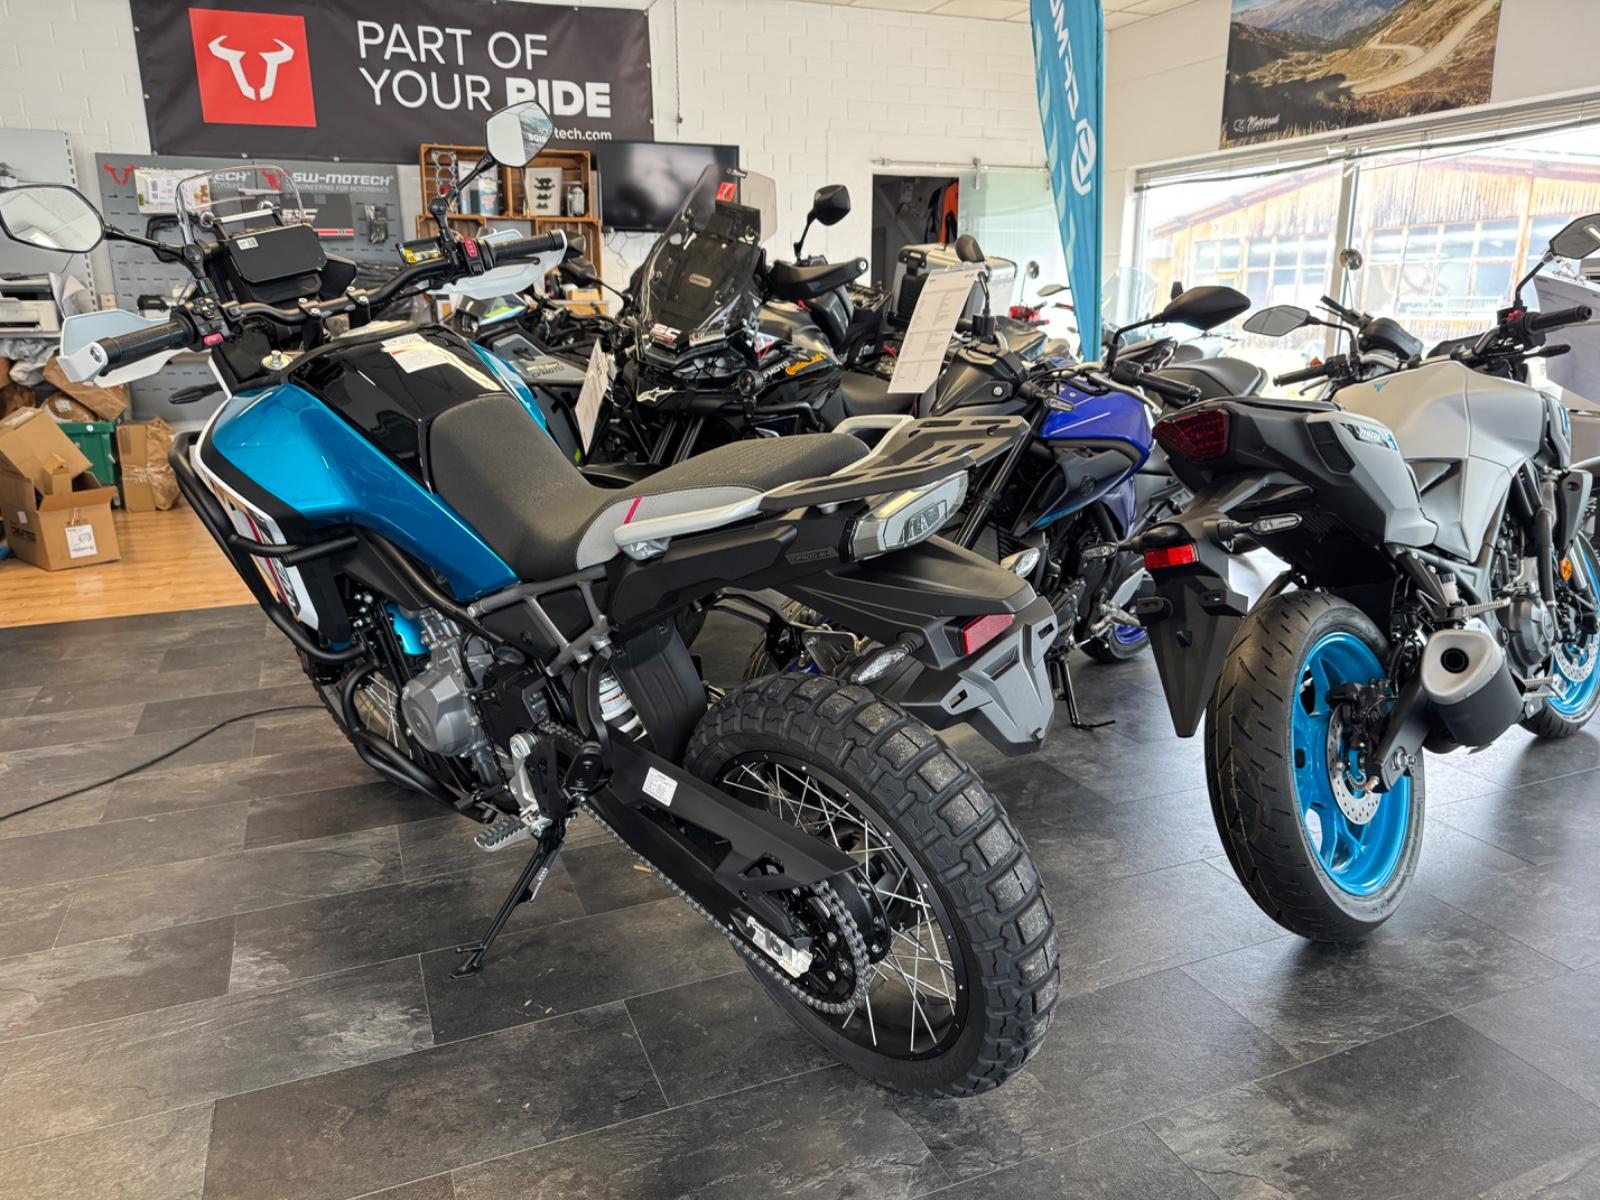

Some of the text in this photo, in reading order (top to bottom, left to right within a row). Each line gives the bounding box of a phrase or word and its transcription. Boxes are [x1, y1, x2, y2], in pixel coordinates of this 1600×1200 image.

[357, 20, 548, 70] PART OF
[359, 67, 612, 118] YOUR RIDE
[553, 127, 612, 141] tech.com
